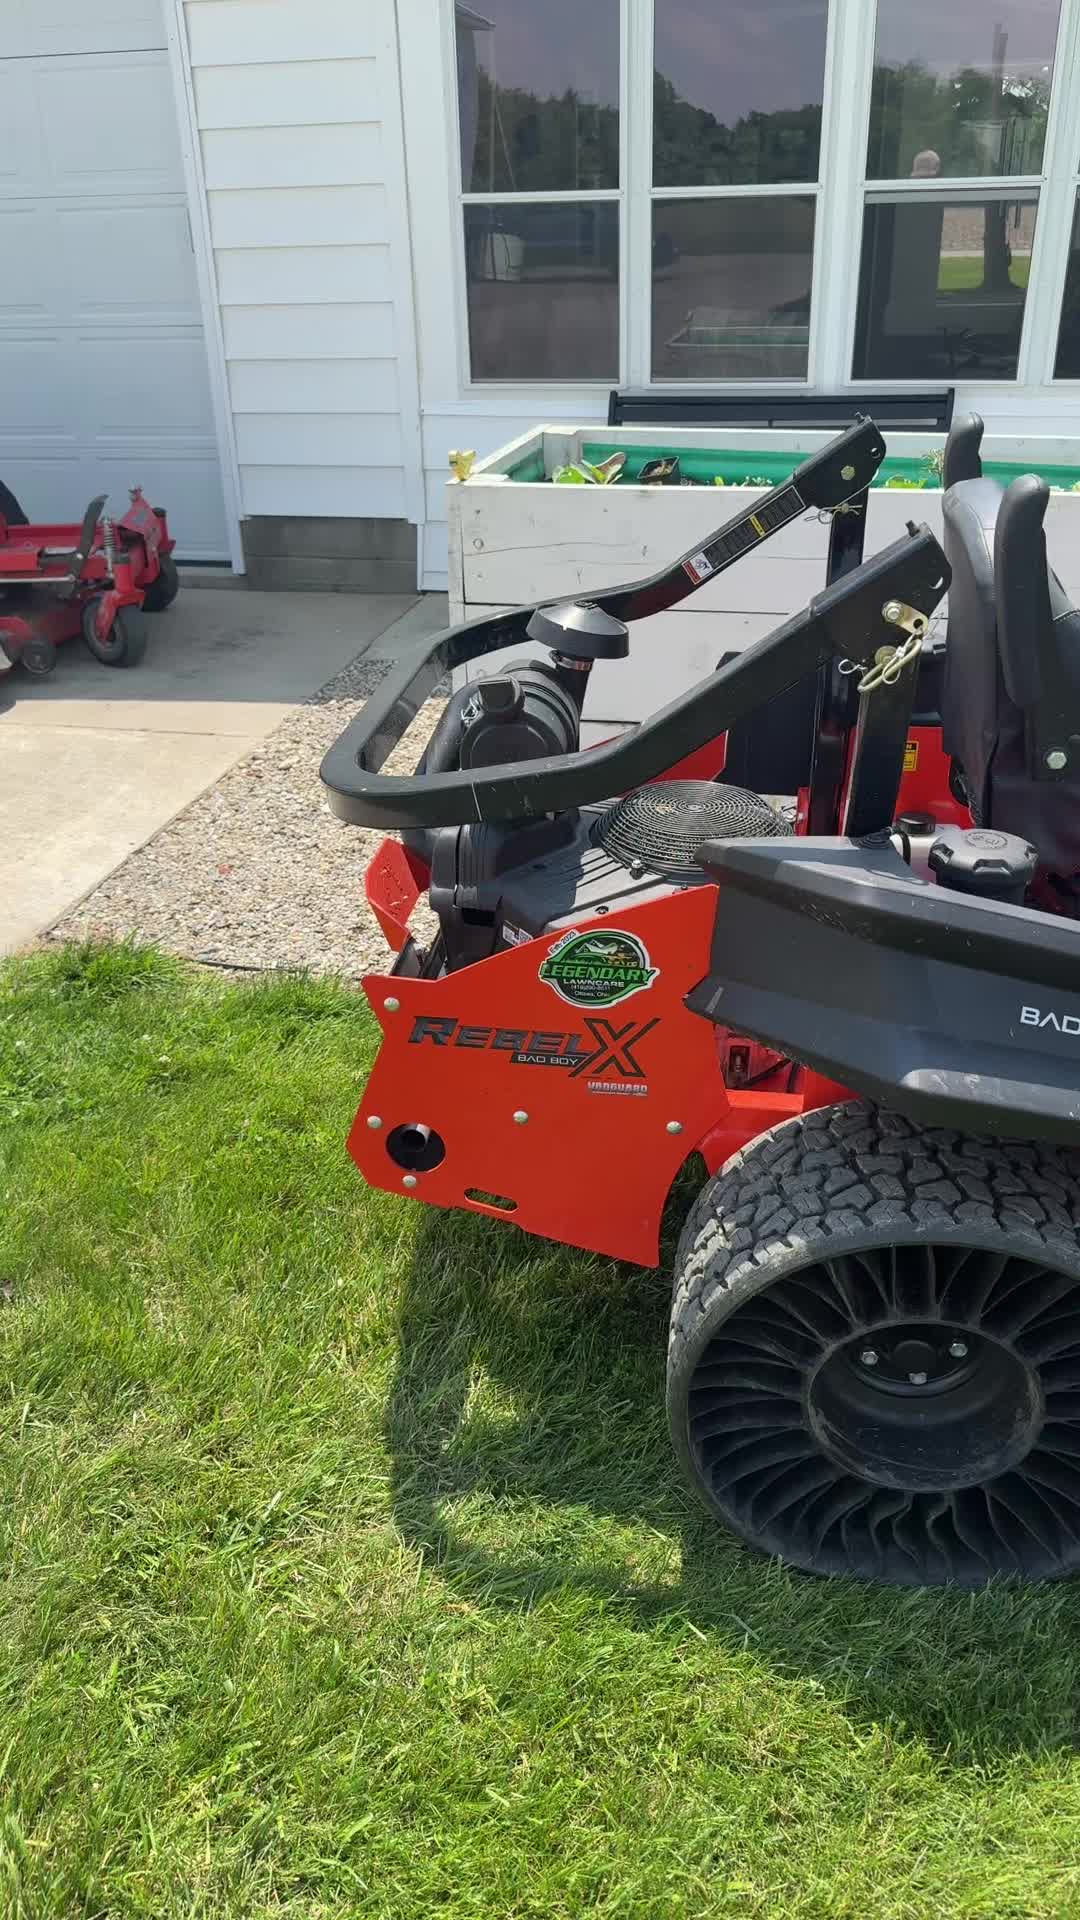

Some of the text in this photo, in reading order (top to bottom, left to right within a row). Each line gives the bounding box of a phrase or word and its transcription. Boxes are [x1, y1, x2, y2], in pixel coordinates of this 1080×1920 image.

[541, 963, 656, 982] LEGENDARY
[563, 978, 625, 988] LAWNCARE
[1020, 1005, 1080, 1036] BAD
[517, 1054, 579, 1066] BAD BOY
[587, 1080, 648, 1093] VANGUARD
